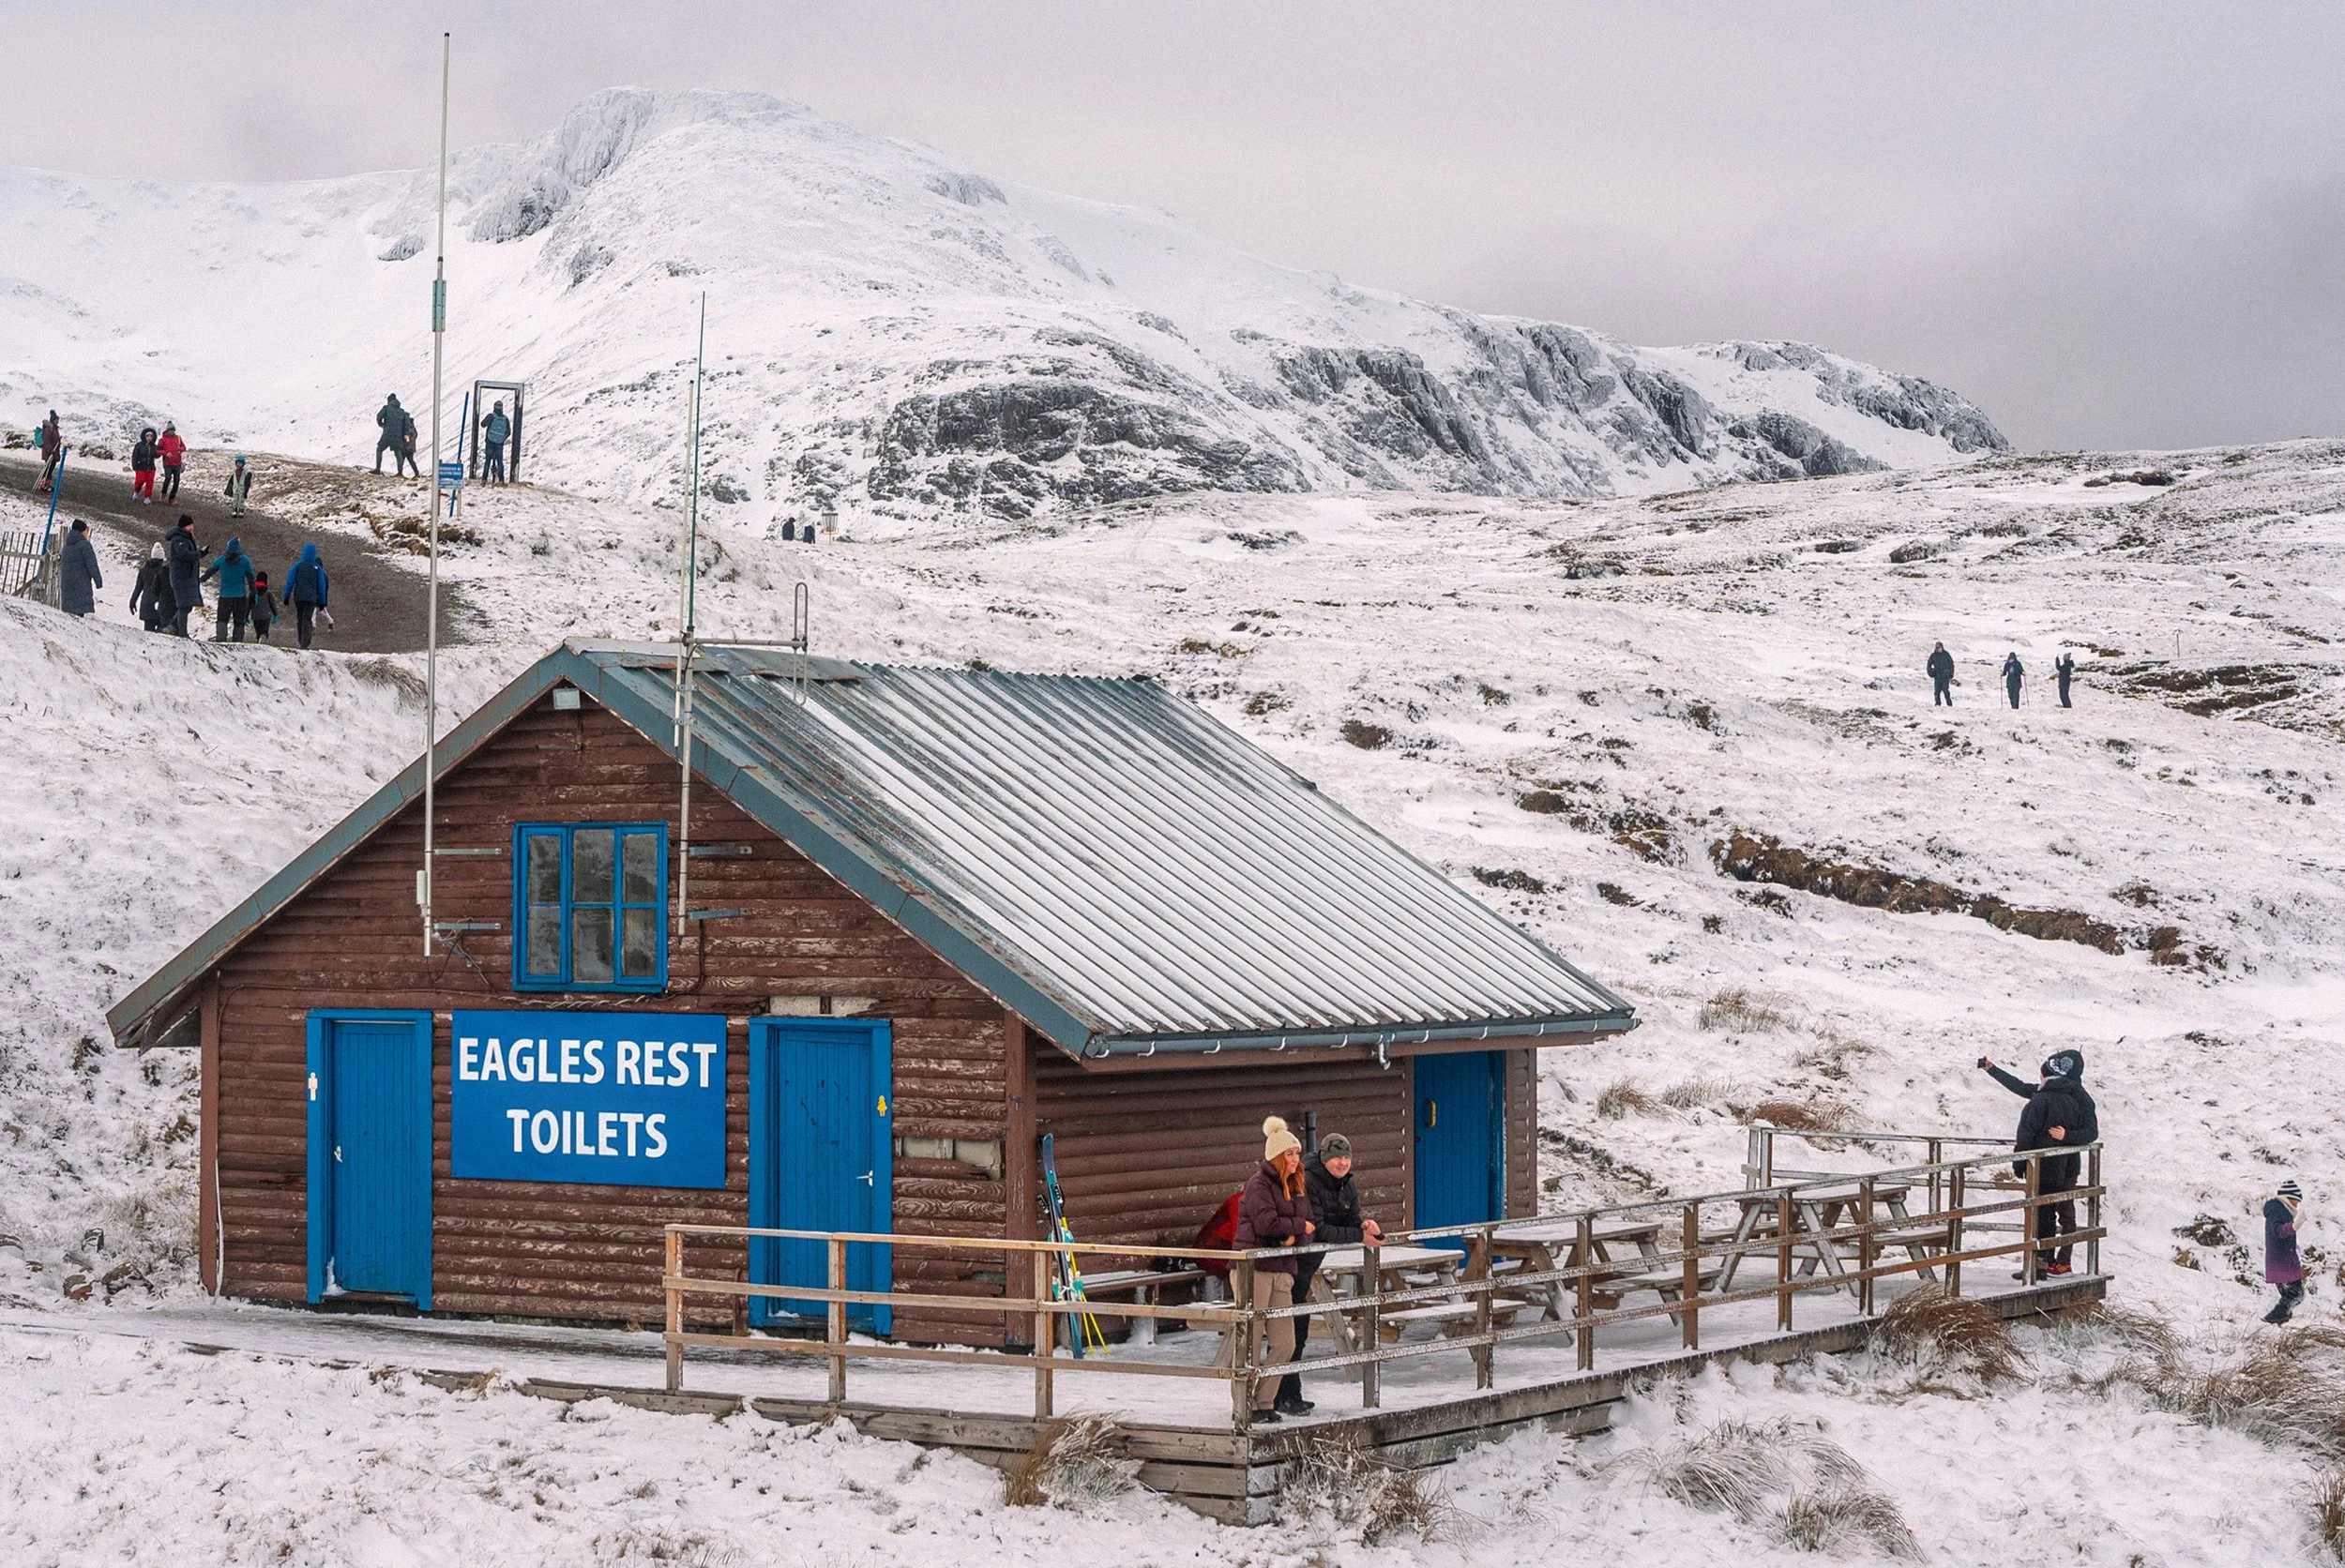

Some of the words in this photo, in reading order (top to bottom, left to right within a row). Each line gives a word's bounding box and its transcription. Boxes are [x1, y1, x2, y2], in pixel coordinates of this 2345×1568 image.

[459, 1037, 605, 1084] EAGLES
[616, 1040, 718, 1088] REST
[507, 1108, 668, 1158] TOILETS
